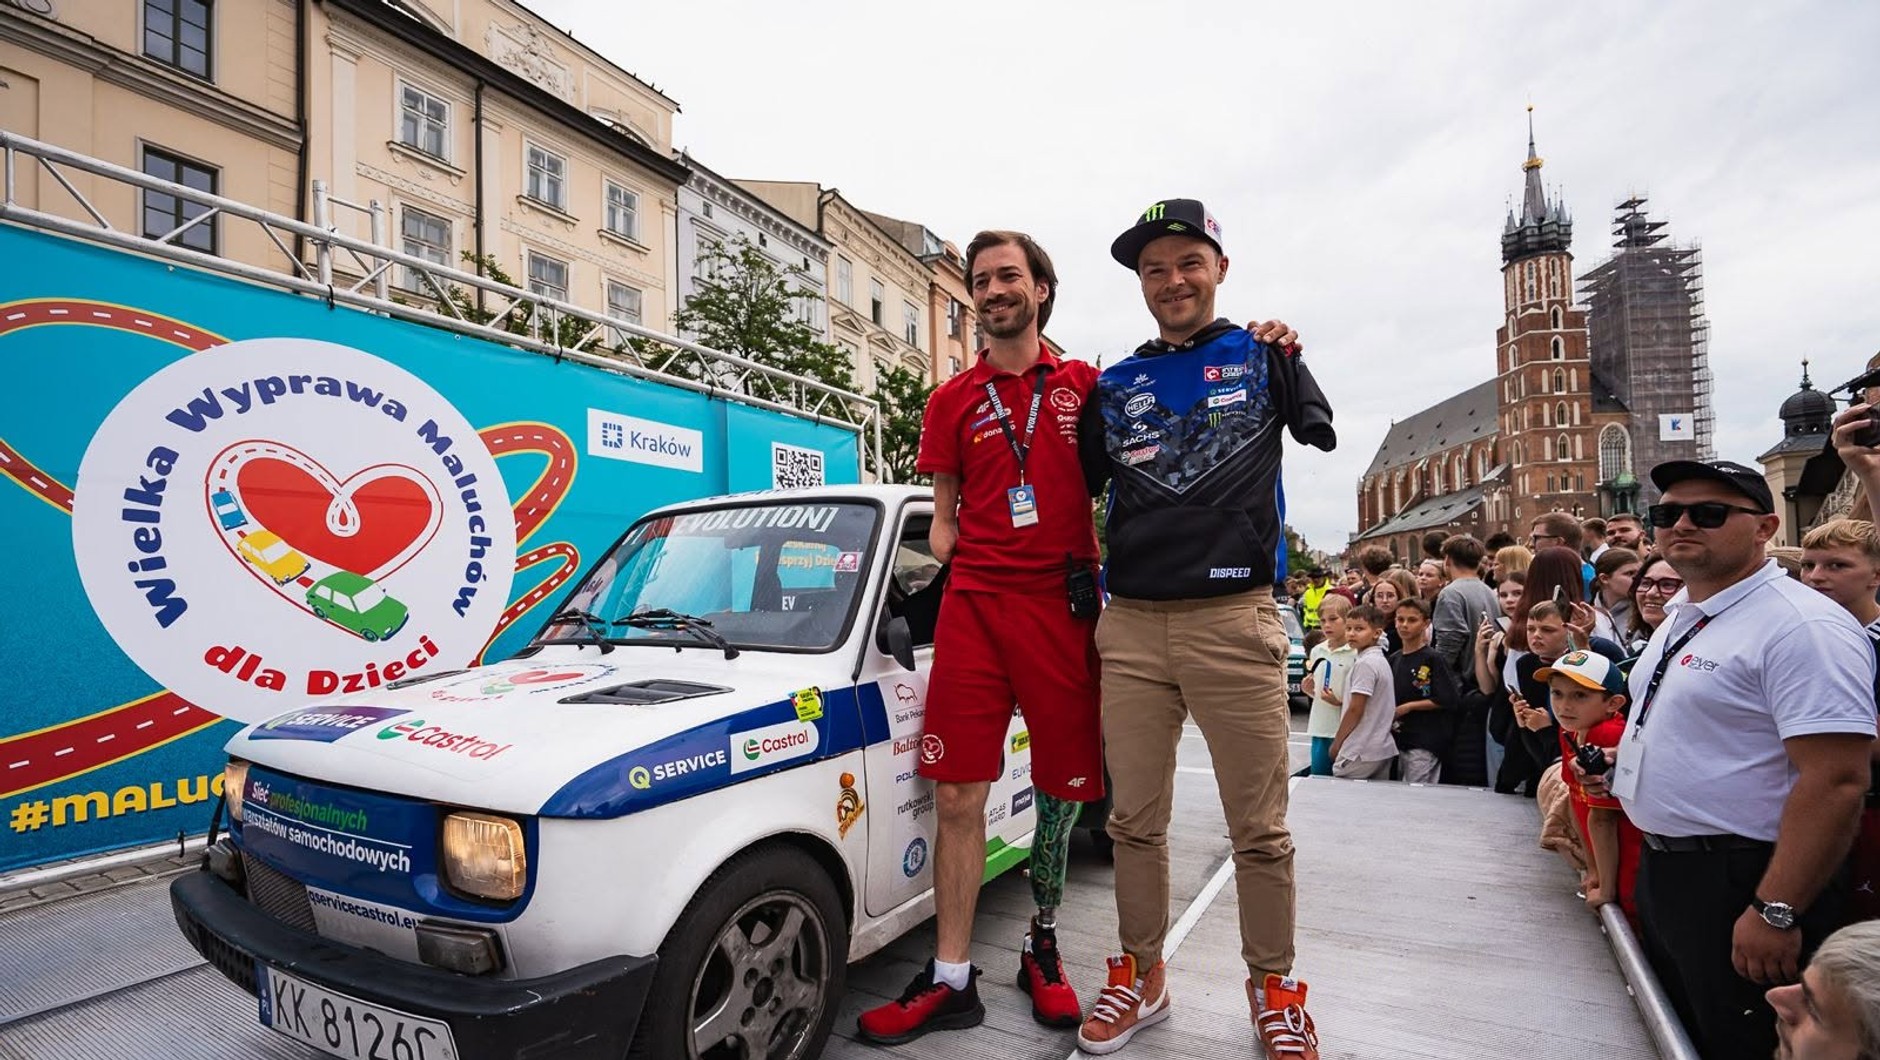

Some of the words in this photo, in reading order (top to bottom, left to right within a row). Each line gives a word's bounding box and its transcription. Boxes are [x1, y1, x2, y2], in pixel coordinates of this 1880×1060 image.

[1127, 396, 1155, 412] HELLA
[630, 431, 691, 458] Kraków
[1122, 431, 1159, 447] SACHS
[122, 446, 188, 628] Wielka
[165, 373, 408, 433] Wyprawa
[417, 418, 492, 618] Maluchów
[1209, 567, 1251, 578] DISPEED
[781, 596, 796, 611] EV
[203, 644, 287, 691] dla
[307, 635, 439, 695] Dzieci
[895, 713, 910, 723] Bank
[408, 726, 513, 760] Castrol
[762, 730, 809, 753] Castrol
[653, 750, 727, 780] SERVICE
[1067, 777, 1087, 787] 4F
[251, 781, 270, 803] Sieć
[270, 790, 368, 831] profesjonalnych
[898, 789, 934, 815] rutkowski
[912, 801, 934, 820] group
[288, 826, 411, 873] samochodowych
[273, 975, 312, 1038] KK
